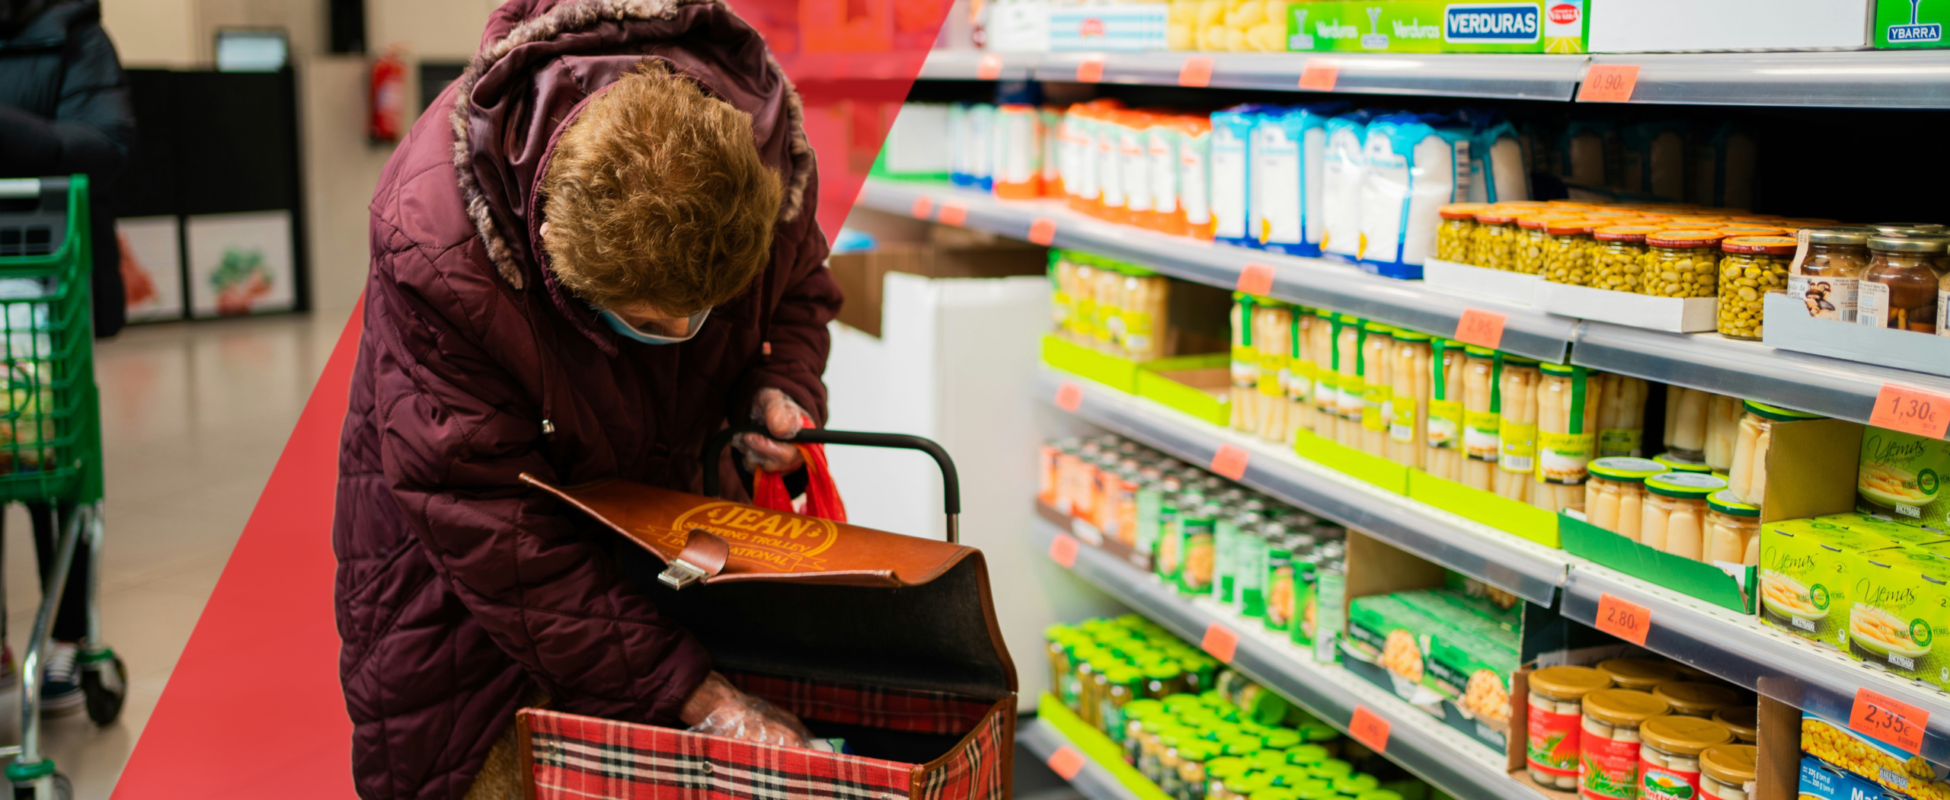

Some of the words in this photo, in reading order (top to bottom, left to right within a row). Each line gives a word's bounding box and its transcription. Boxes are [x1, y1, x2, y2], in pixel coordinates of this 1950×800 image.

[1392, 17, 1440, 39] Verduras
[1449, 13, 1536, 34] VERDURAS
[1891, 26, 1938, 39] YBARRA
[1892, 396, 1937, 422] 1,30€
[1866, 434, 1929, 467] Yemas
[710, 505, 816, 539] JEAN
[670, 537, 789, 566] INATIONAL
[750, 535, 811, 552] TROLLEY
[1765, 546, 1819, 577] Yemas
[1856, 578, 1920, 611] Yemas
[1864, 704, 1911, 737] 2,35€
